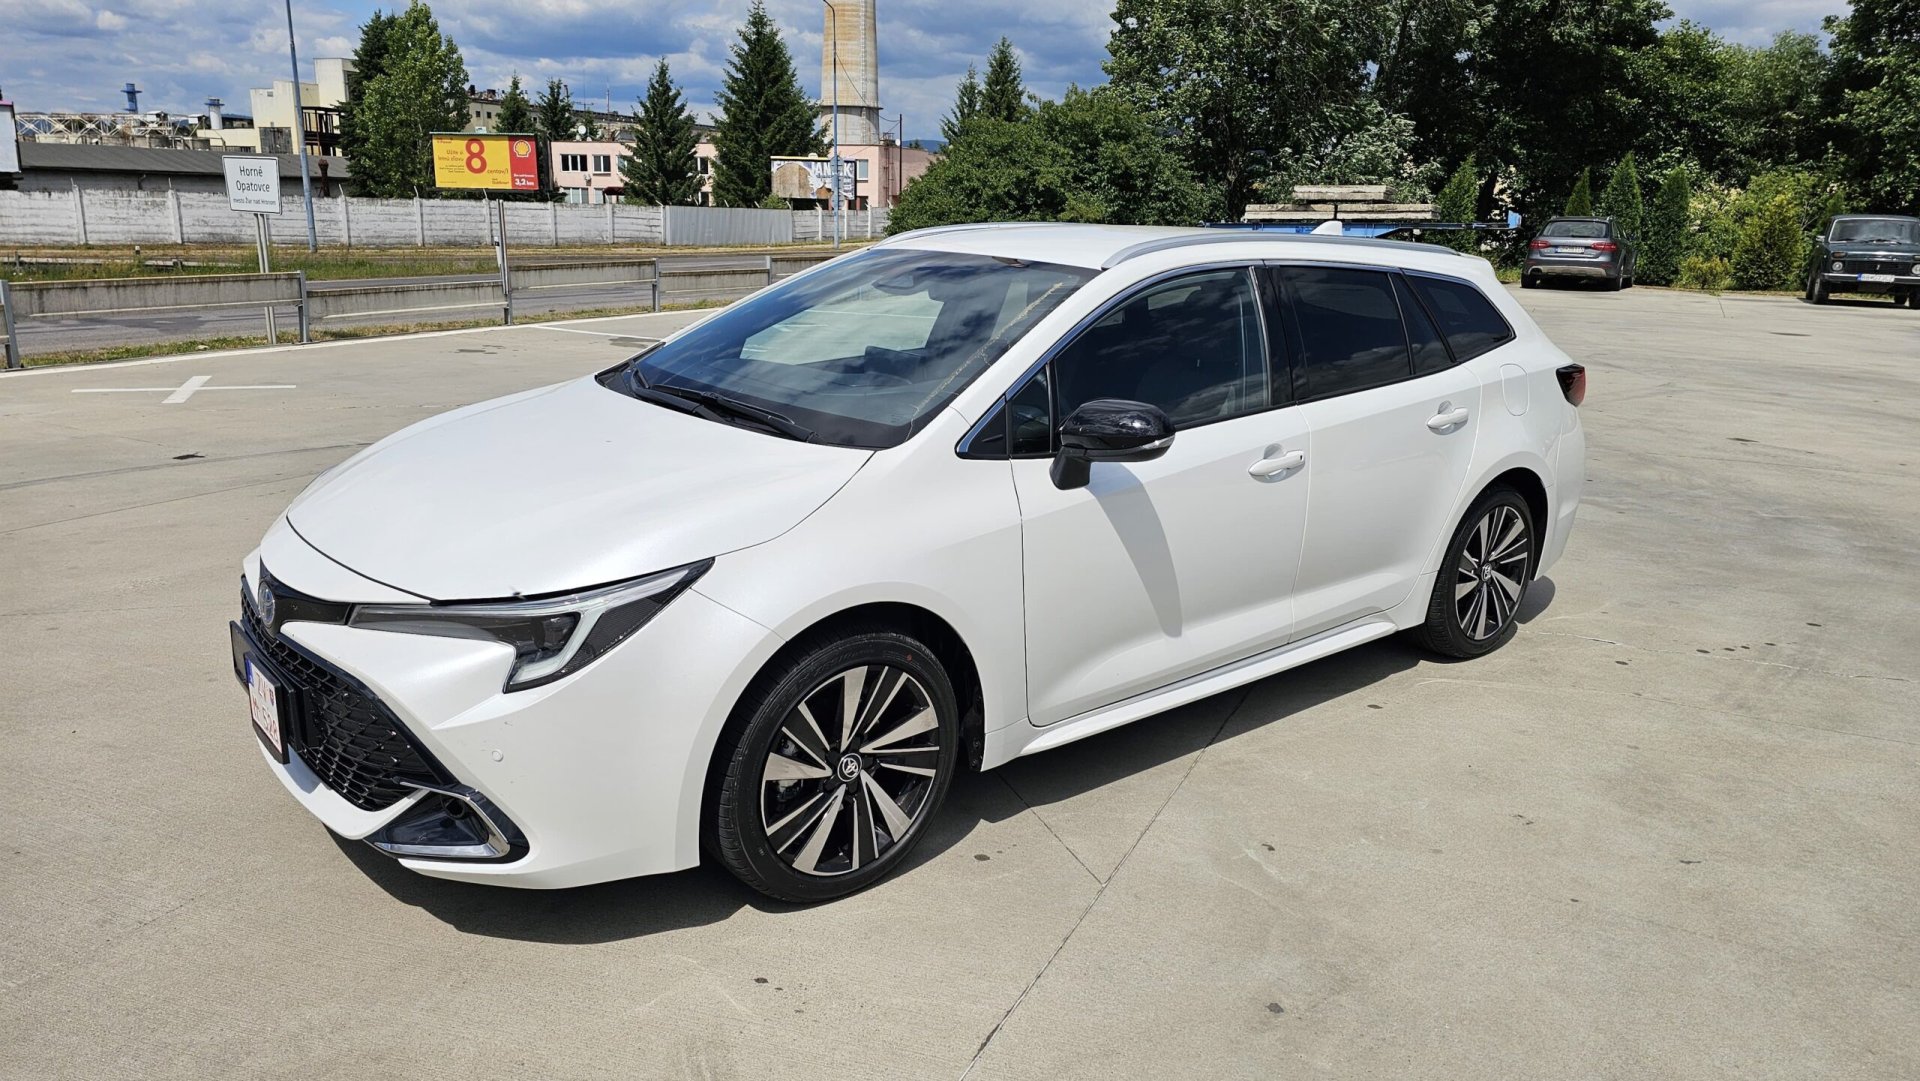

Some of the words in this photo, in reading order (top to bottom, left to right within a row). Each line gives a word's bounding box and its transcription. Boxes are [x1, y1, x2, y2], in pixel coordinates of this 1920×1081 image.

[465, 138, 487, 174] 8
[239, 165, 263, 177] Horné
[235, 180, 270, 193] Opatovce
